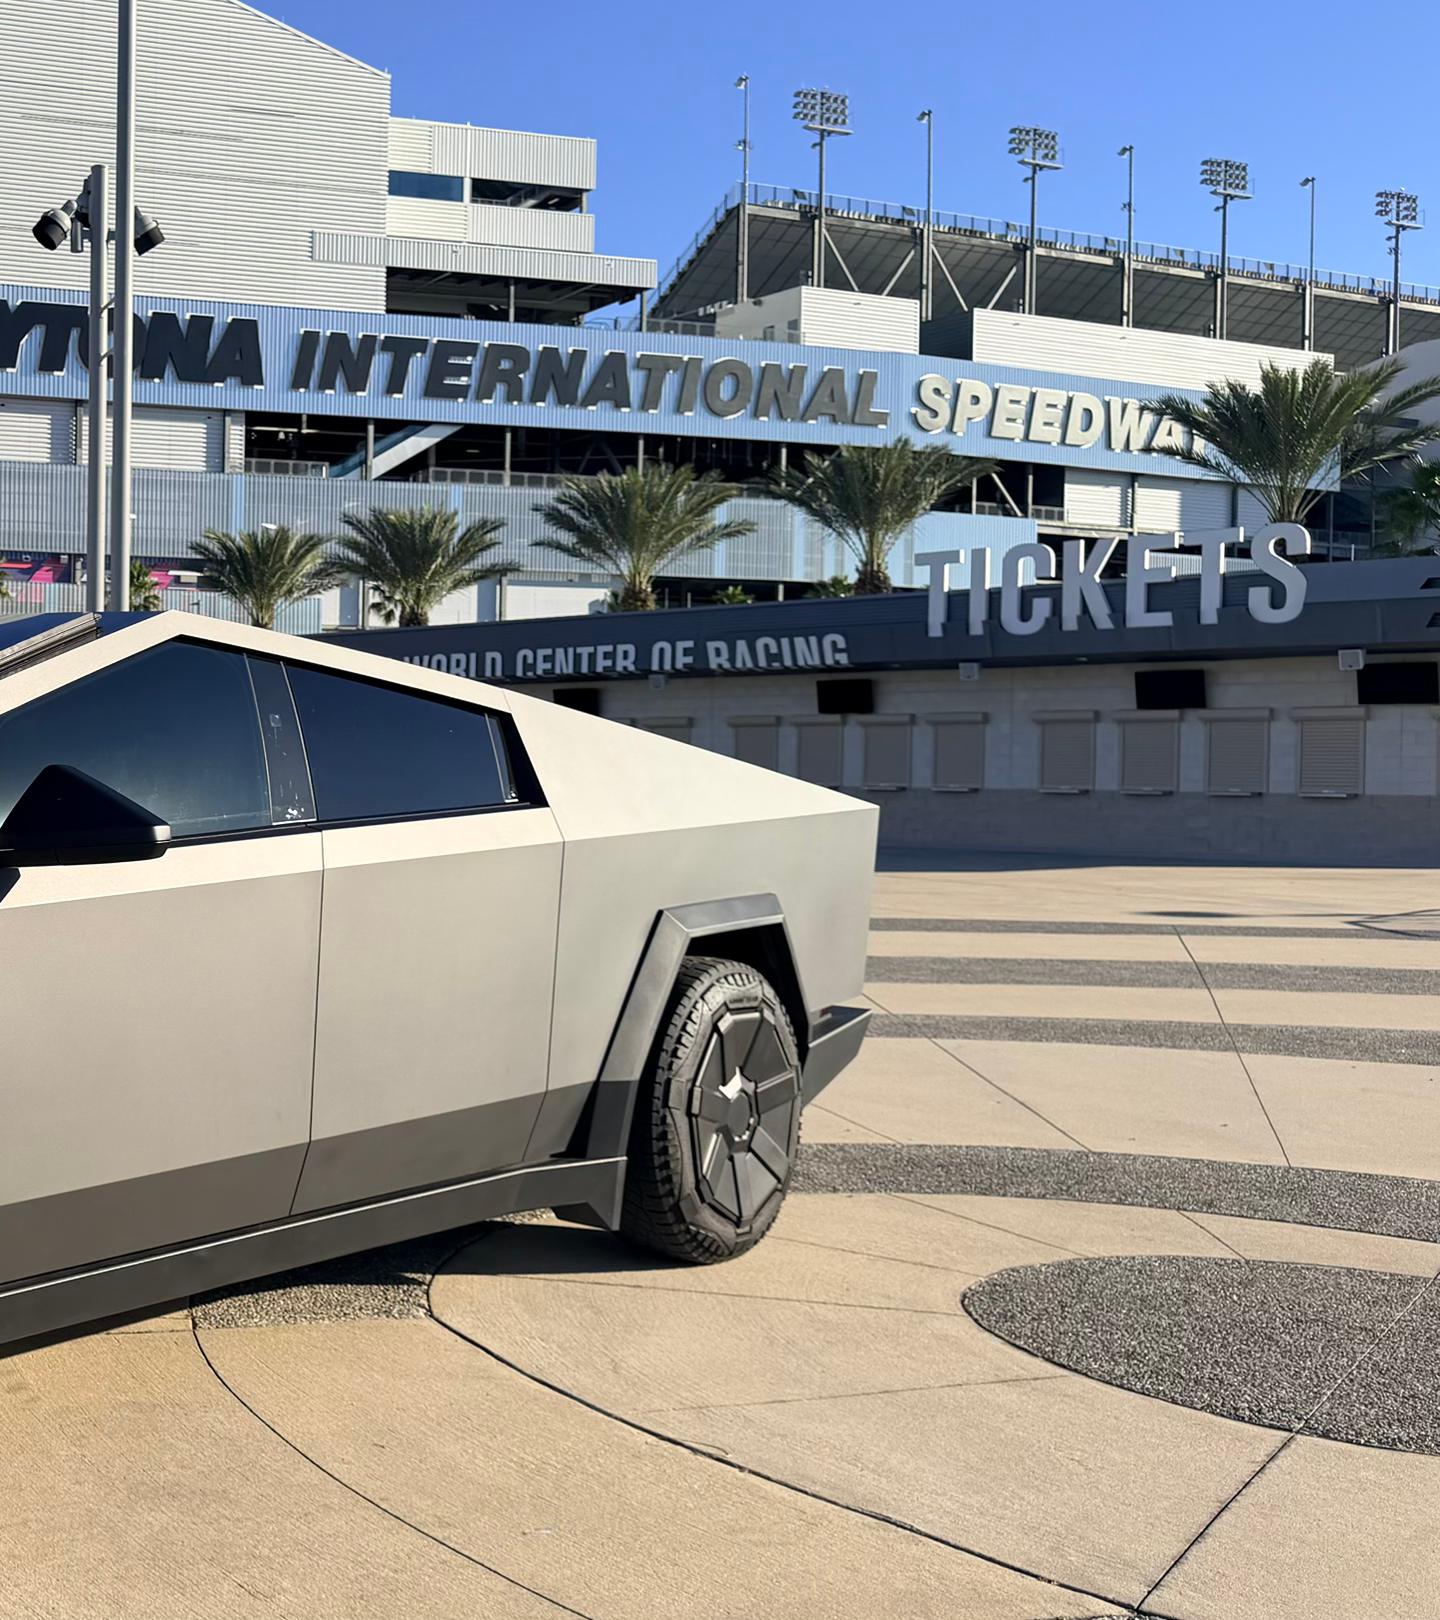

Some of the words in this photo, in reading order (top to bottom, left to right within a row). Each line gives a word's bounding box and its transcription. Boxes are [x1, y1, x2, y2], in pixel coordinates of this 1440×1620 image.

[291, 328, 890, 428] INTERNATIONAL
[911, 372, 1208, 457] SPEEDWA
[914, 522, 1311, 639] TICKETS
[516, 643, 637, 677] CENTER
[651, 640, 695, 672] OF
[706, 633, 850, 671] RACING
